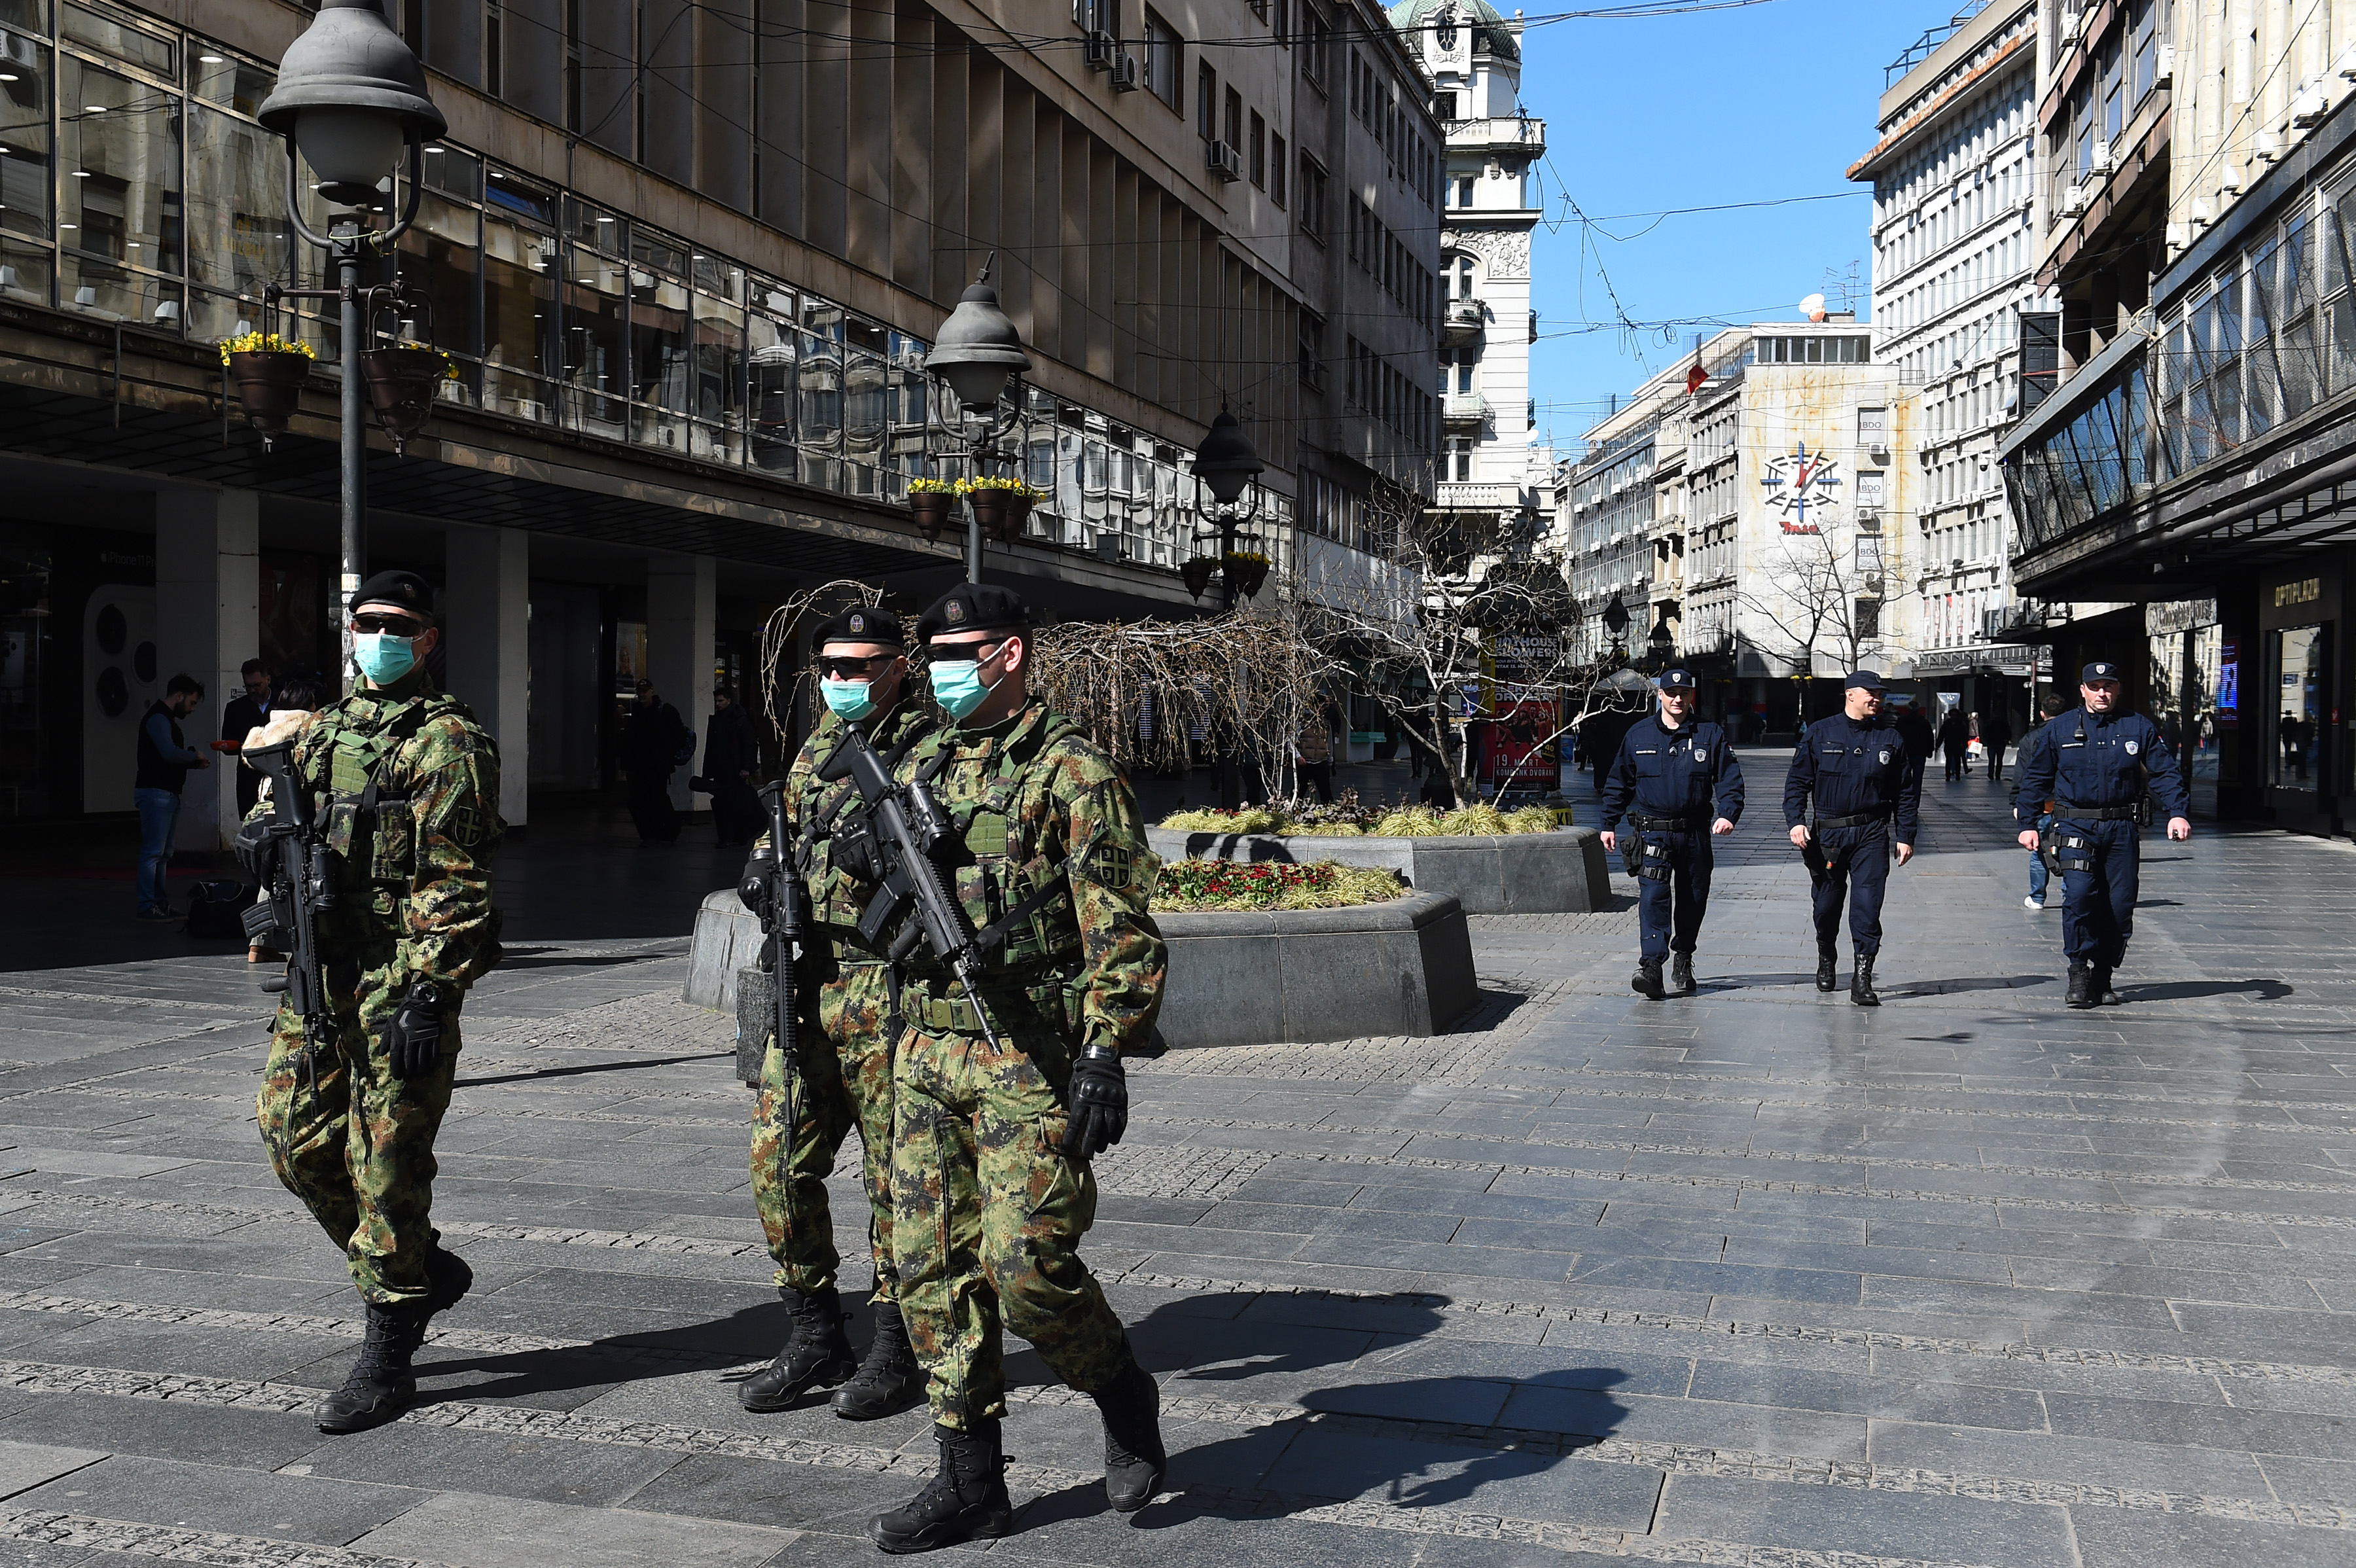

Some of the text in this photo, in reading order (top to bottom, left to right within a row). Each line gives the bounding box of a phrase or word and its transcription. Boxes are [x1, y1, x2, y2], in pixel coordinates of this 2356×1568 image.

[107, 551, 136, 565] iPhone
[137, 554, 145, 566] 11
[1495, 754, 1511, 766] 19.
